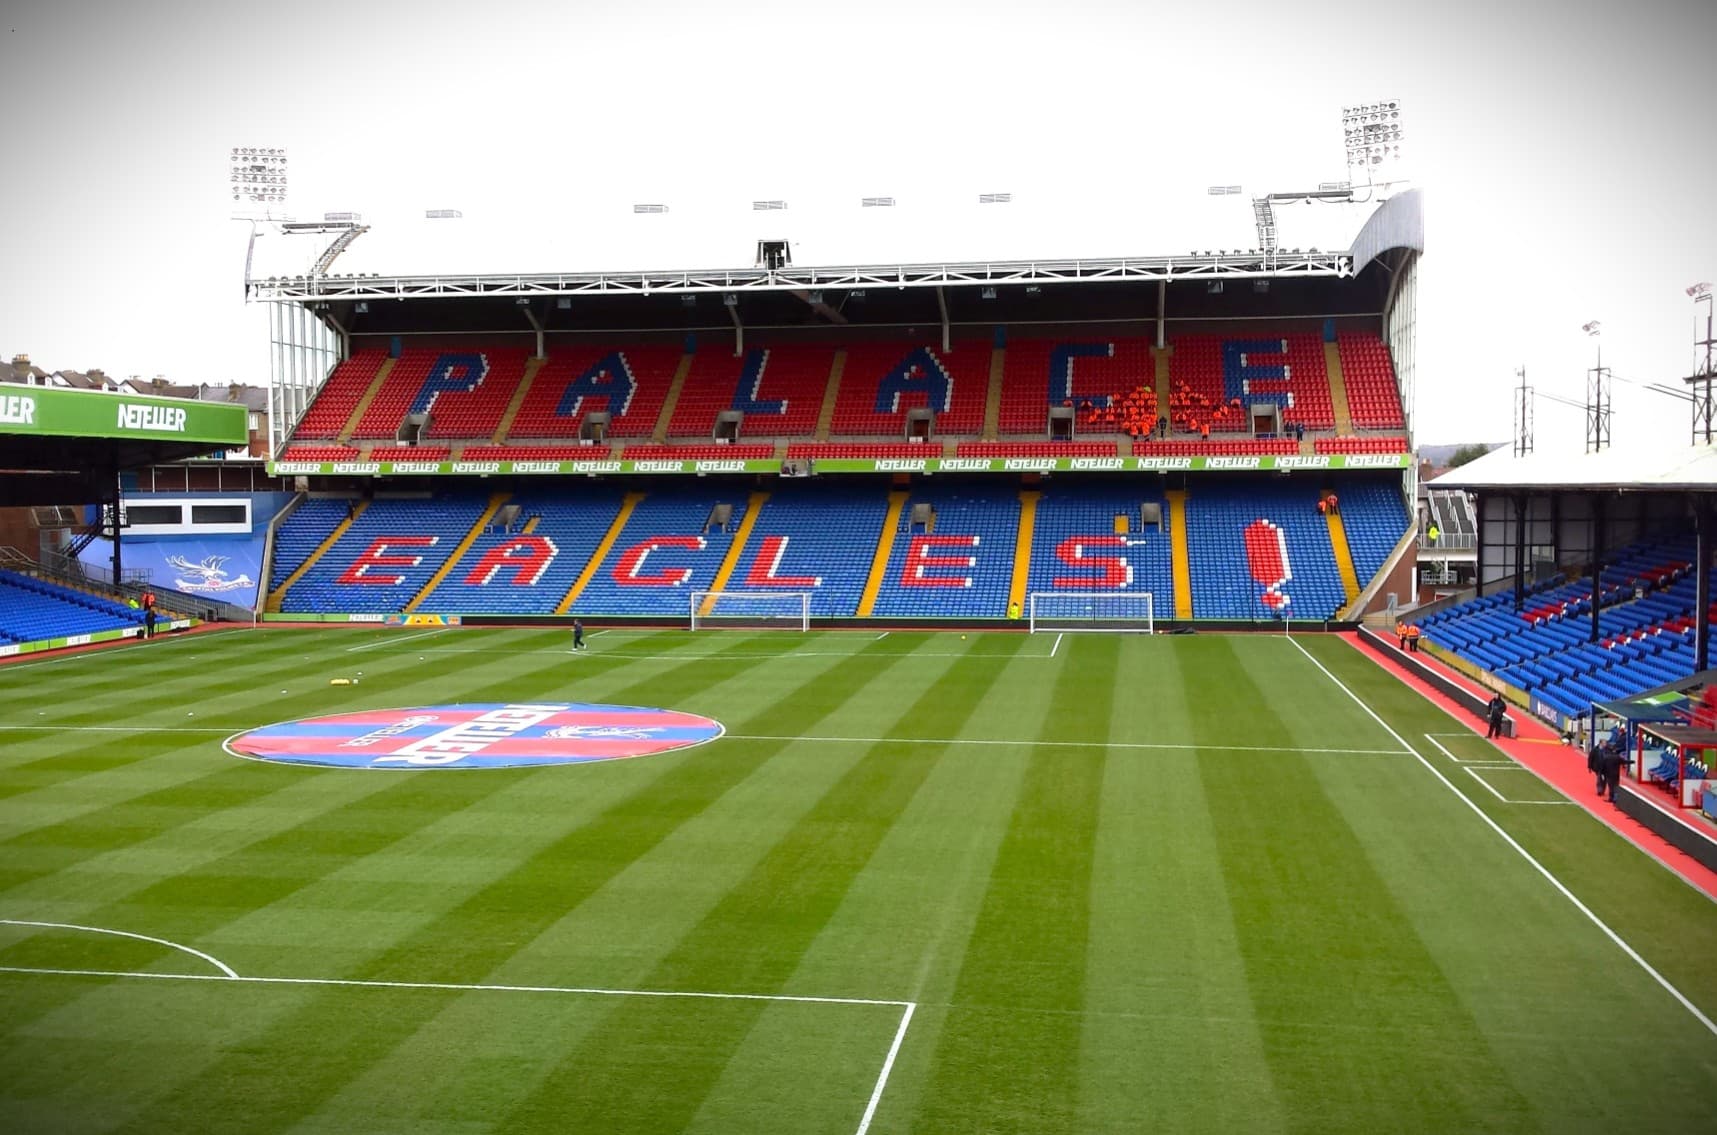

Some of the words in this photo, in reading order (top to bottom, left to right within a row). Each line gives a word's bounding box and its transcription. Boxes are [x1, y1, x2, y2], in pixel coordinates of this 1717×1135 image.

[118, 403, 187, 432] NETELLER
[274, 463, 321, 473] NETELLER
[333, 463, 380, 473] NETELLER
[392, 463, 439, 473] NETELLER
[452, 462, 500, 472] NETELLER
[512, 462, 560, 472] NETELLER
[572, 461, 621, 472] NETELLER
[633, 461, 682, 472] NETELLER
[695, 461, 745, 471] NETELLER
[875, 460, 926, 470] NETELLER
[939, 459, 991, 470] NETELLER
[1004, 459, 1057, 469] NETELLER
[1070, 458, 1123, 469] NETELLER
[1137, 457, 1191, 468] NETELLER
[1205, 457, 1260, 468] NETELLER
[1274, 456, 1330, 467] NETELLER
[1344, 455, 1401, 467] NETELLER
